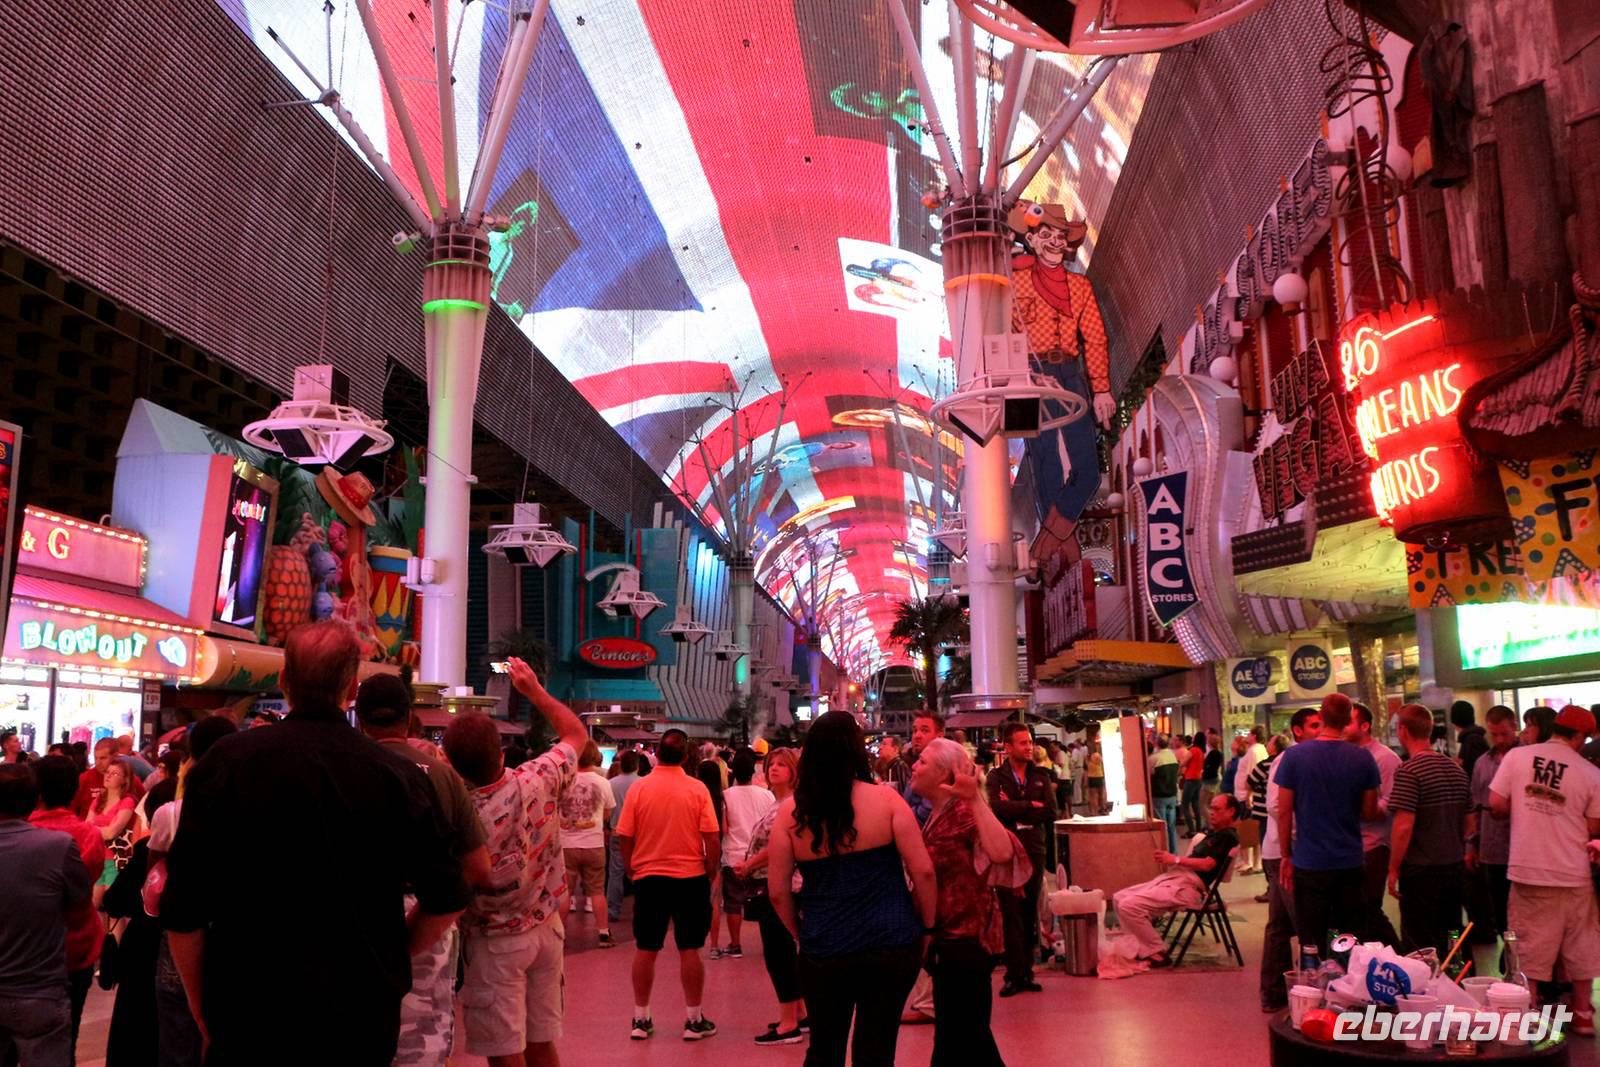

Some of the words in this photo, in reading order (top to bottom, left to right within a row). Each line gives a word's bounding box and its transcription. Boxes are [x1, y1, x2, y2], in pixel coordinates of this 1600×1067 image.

[21, 530, 36, 552] &
[48, 527, 70, 559] G
[1147, 482, 1184, 588] ABC
[1151, 593, 1194, 602] STORES
[21, 621, 148, 663] BLOWOUT
[1295, 656, 1327, 670] ABC
[1532, 756, 1568, 780] EAT
[1533, 767, 1560, 790] ME
